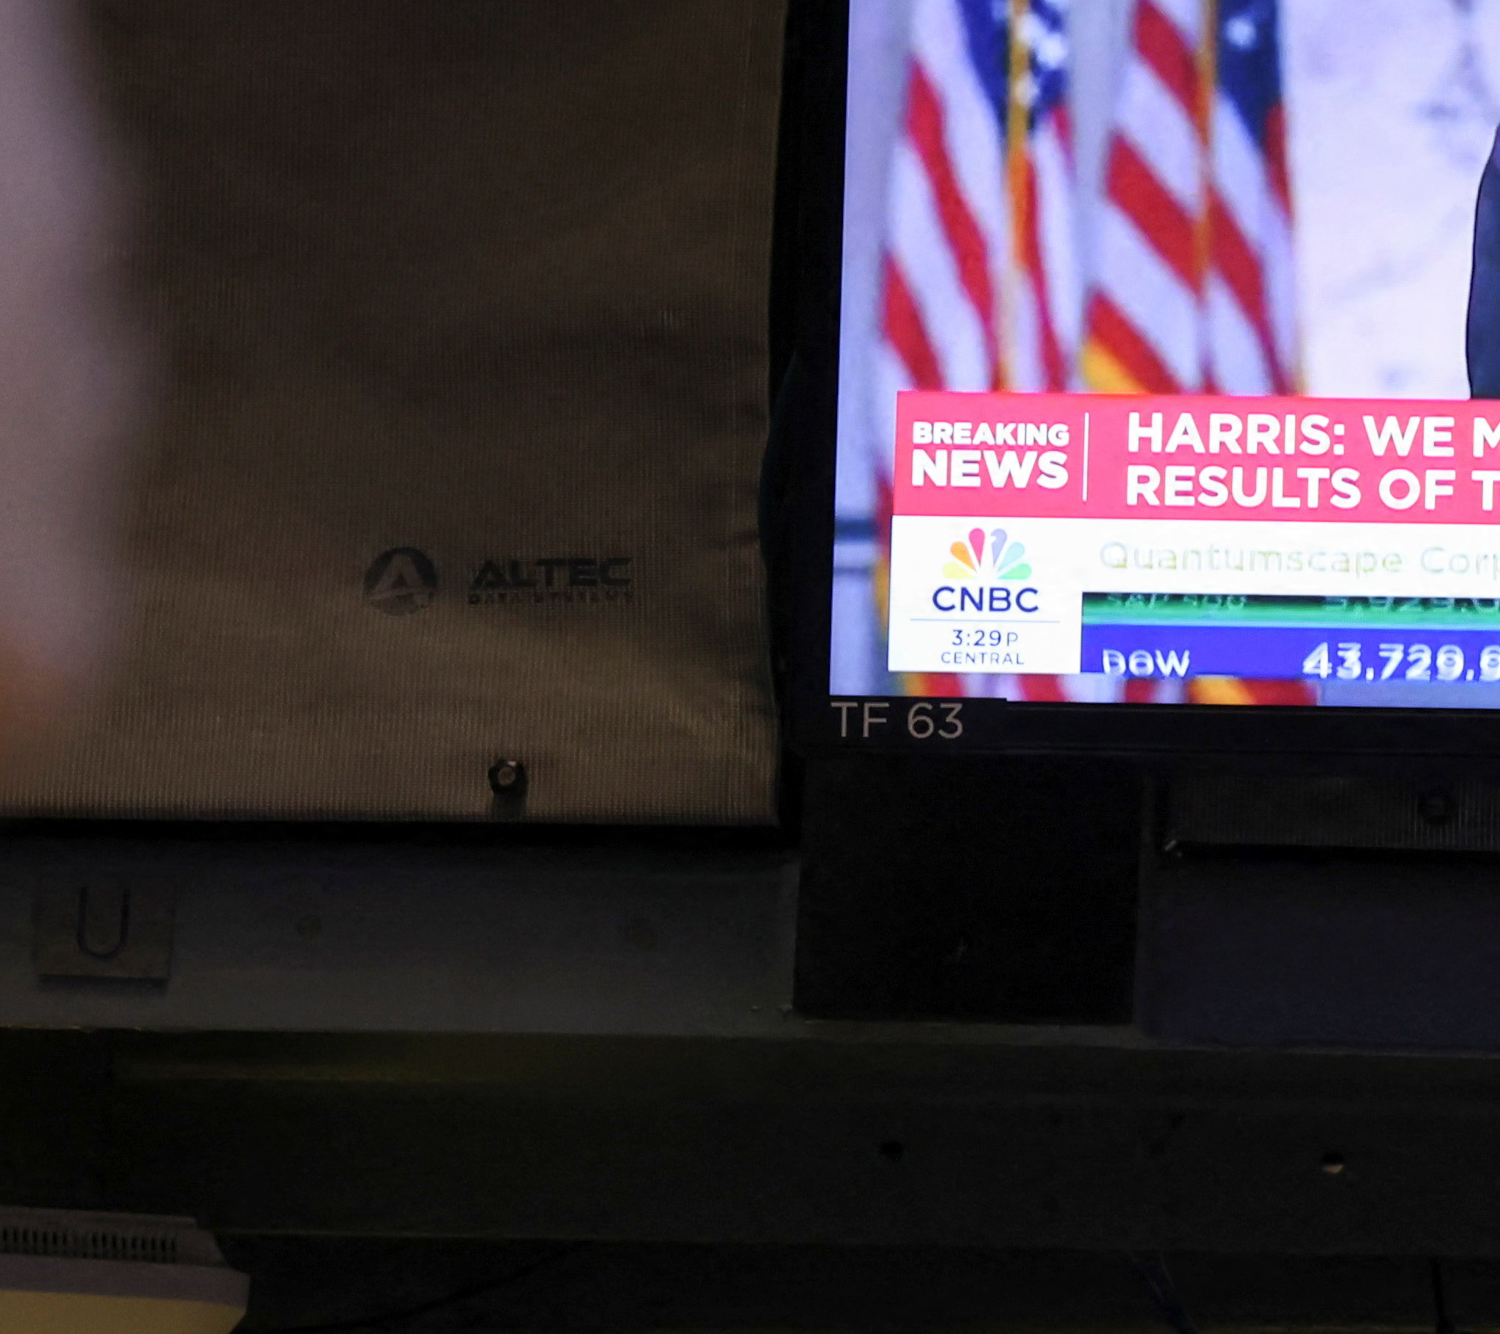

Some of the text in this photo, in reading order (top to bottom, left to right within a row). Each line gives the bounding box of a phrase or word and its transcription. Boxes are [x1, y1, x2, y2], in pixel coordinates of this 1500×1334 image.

[912, 422, 1069, 447] BREAKING
[1127, 412, 1345, 455] HARRIS:
[1363, 415, 1455, 457] WE
[911, 450, 1069, 488] NEWS
[1126, 466, 1361, 510] RESULTS
[1378, 469, 1455, 511] OF
[469, 556, 631, 589] ALTEC
[1100, 542, 1402, 578] Quantumscape
[932, 585, 1040, 612] CNBC
[940, 651, 1025, 665] CENTRAL
[831, 701, 964, 739] TF 63
[76, 886, 131, 962] U
